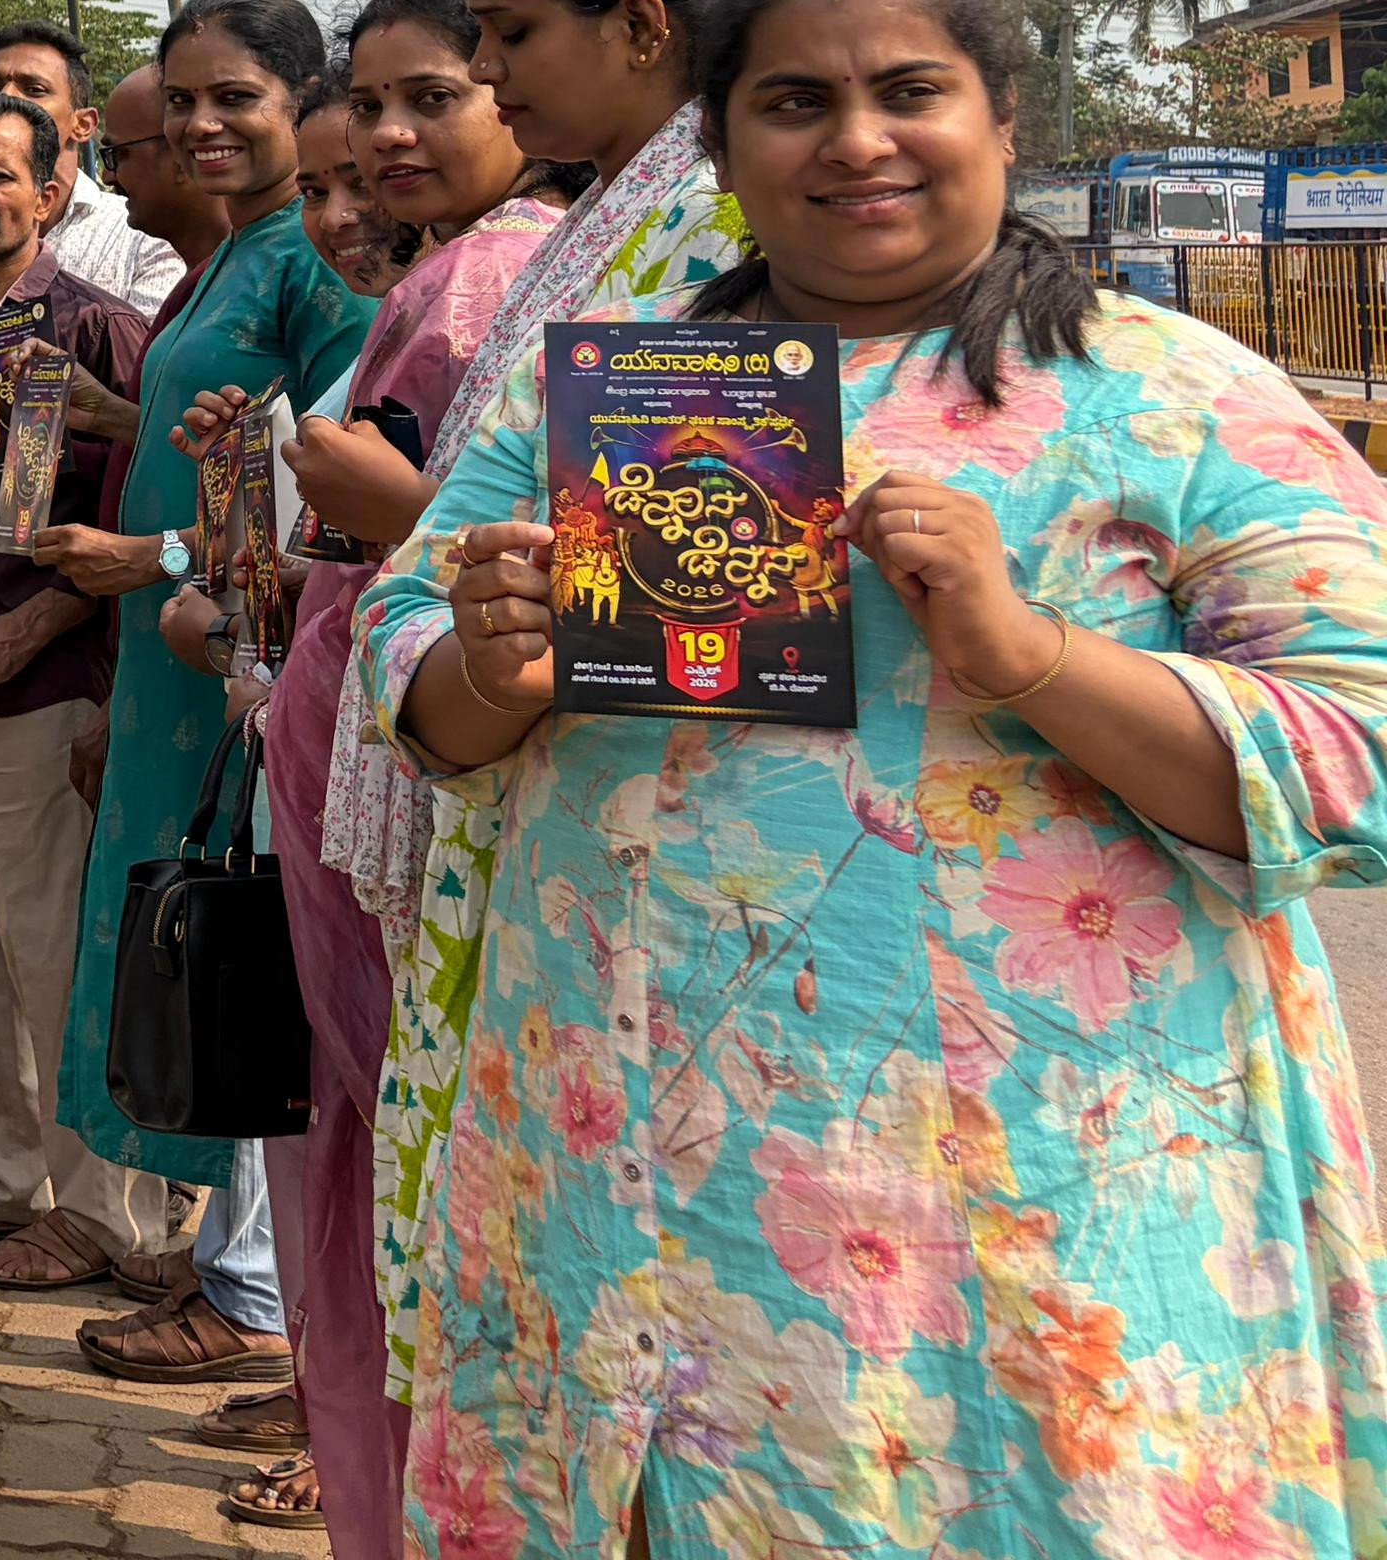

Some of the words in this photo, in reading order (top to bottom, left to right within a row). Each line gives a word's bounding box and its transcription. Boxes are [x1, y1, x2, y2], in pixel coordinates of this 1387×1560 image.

[1168, 146, 1216, 161] GOODS
[1307, 189, 1331, 207] भारत
[610, 349, 740, 375] ಯುವವಾಹಿನಿ
[660, 578, 725, 598] 2026
[678, 631, 726, 664] 19
[689, 677, 718, 688] 2026
